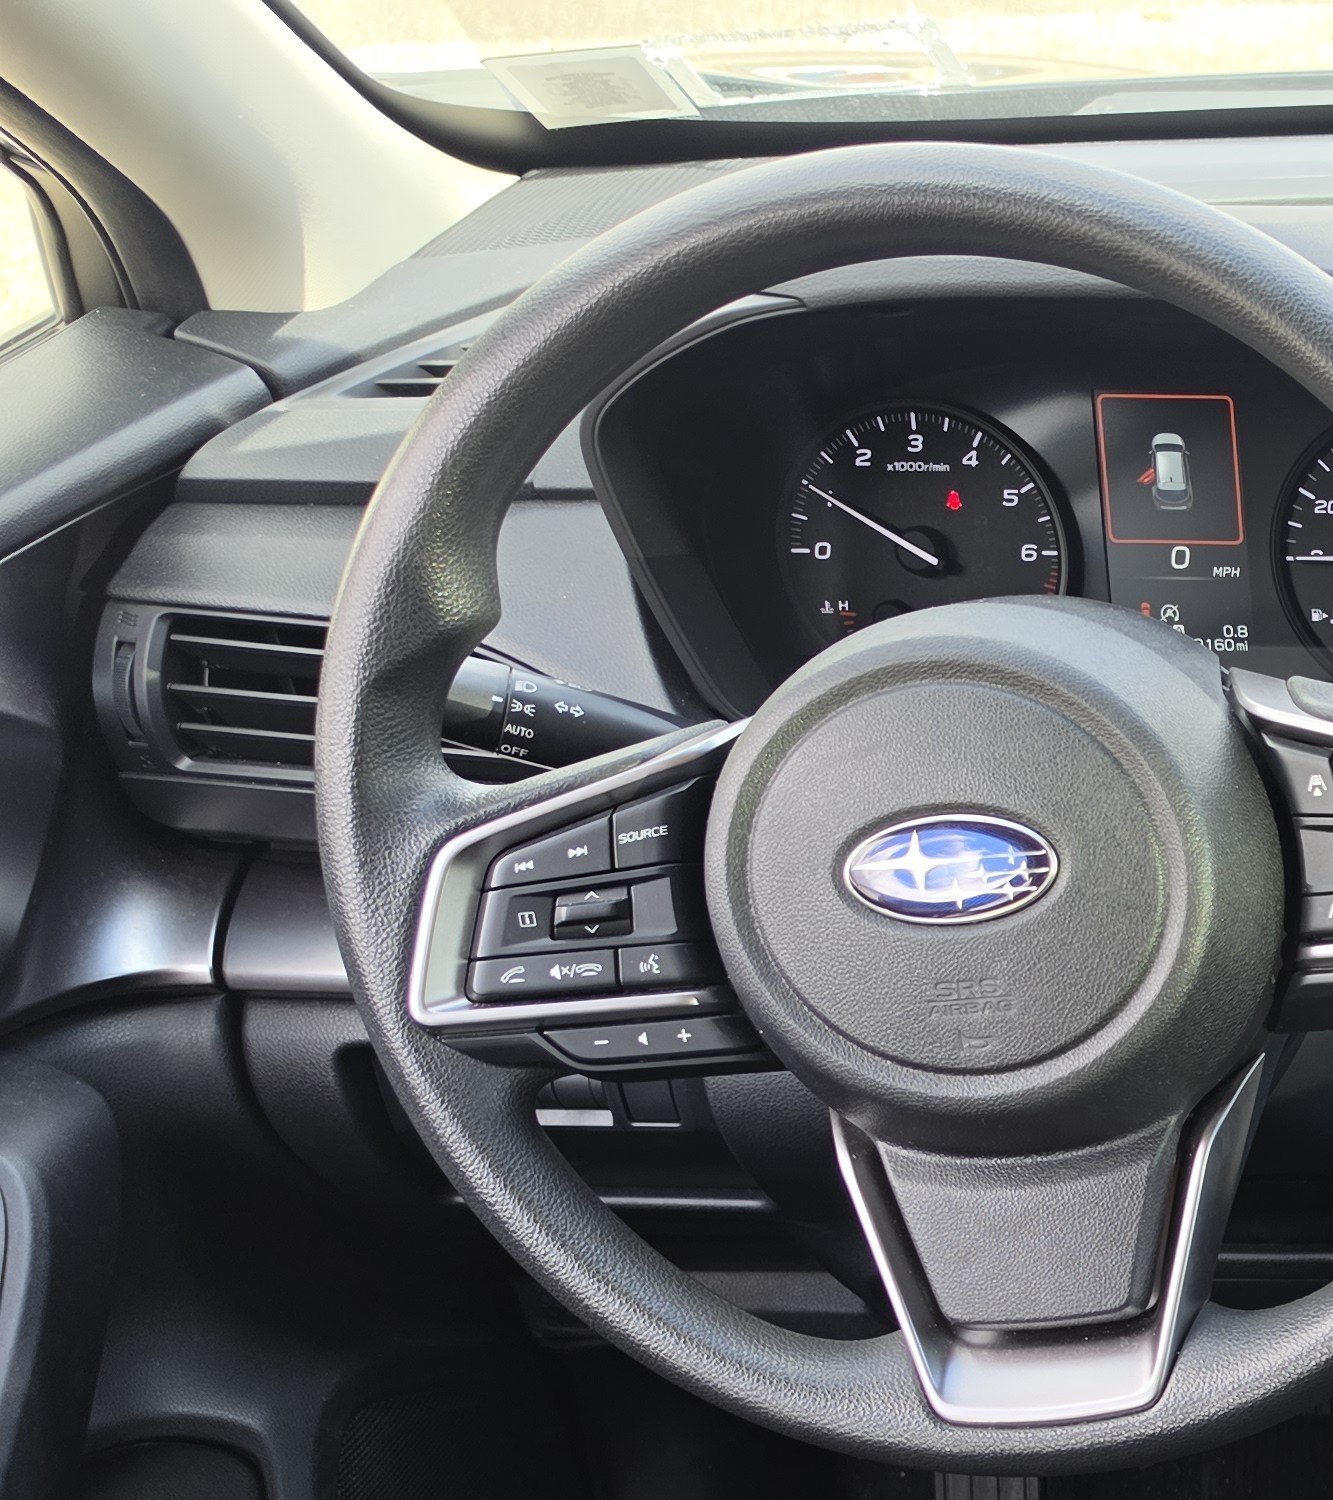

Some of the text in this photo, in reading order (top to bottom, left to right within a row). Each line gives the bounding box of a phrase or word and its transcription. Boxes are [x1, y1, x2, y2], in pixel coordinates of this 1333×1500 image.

[907, 433, 924, 453] 3
[855, 449, 872, 467] 2
[962, 450, 979, 468] 4
[886, 462, 950, 473] x1000r/min
[1002, 488, 1019, 507] 5
[814, 541, 832, 560] 0
[1020, 543, 1038, 562] 6
[1171, 545, 1191, 570] 0
[1212, 566, 1241, 578] MPH
[838, 600, 849, 611] H
[1223, 624, 1249, 638] 0.8
[503, 723, 535, 740] AUTO
[500, 743, 529, 758] OFF
[618, 825, 669, 845] SOURCE
[934, 977, 1003, 1000] SRS
[928, 1000, 1015, 1018] AIRBAG
